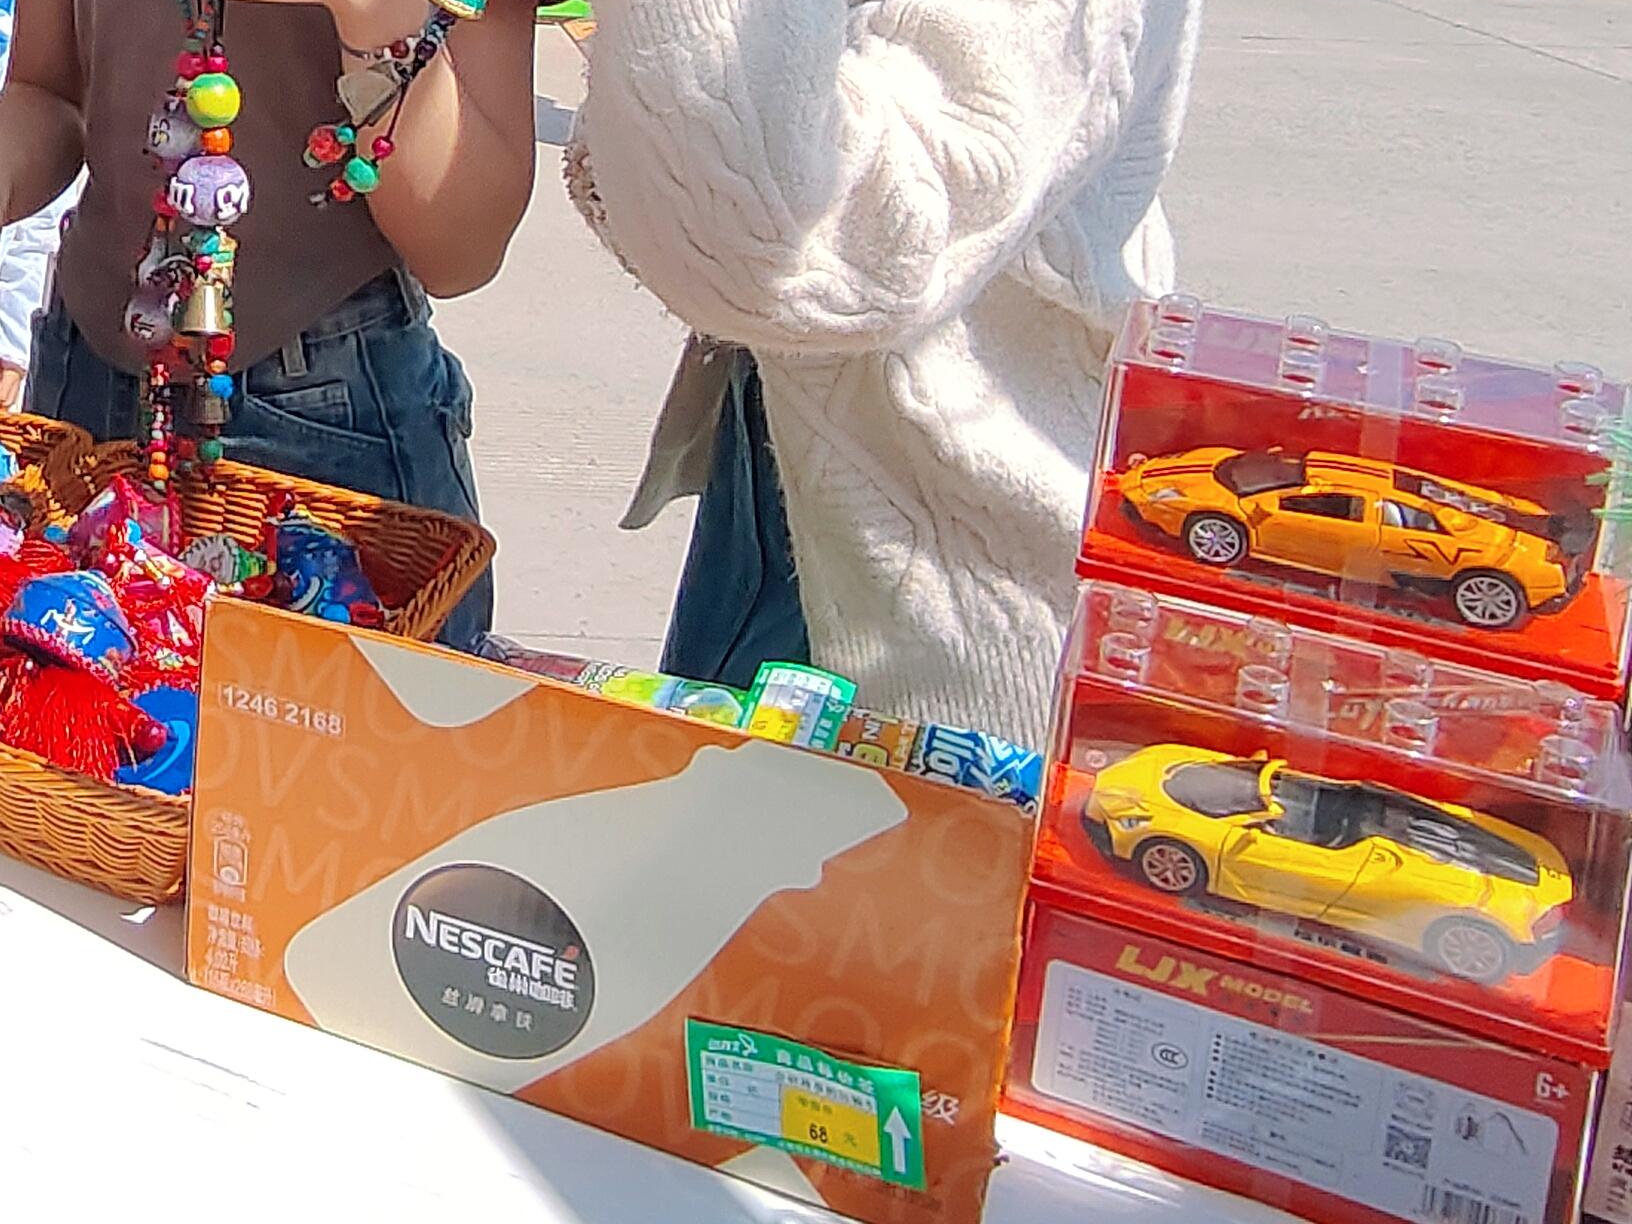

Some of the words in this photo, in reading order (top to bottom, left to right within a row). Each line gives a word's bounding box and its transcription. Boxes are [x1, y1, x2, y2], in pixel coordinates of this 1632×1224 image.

[222, 685, 278, 719] 1246
[284, 702, 343, 736] 2168
[1536, 1072, 1568, 1100] 6+
[808, 1123, 828, 1145] 68
